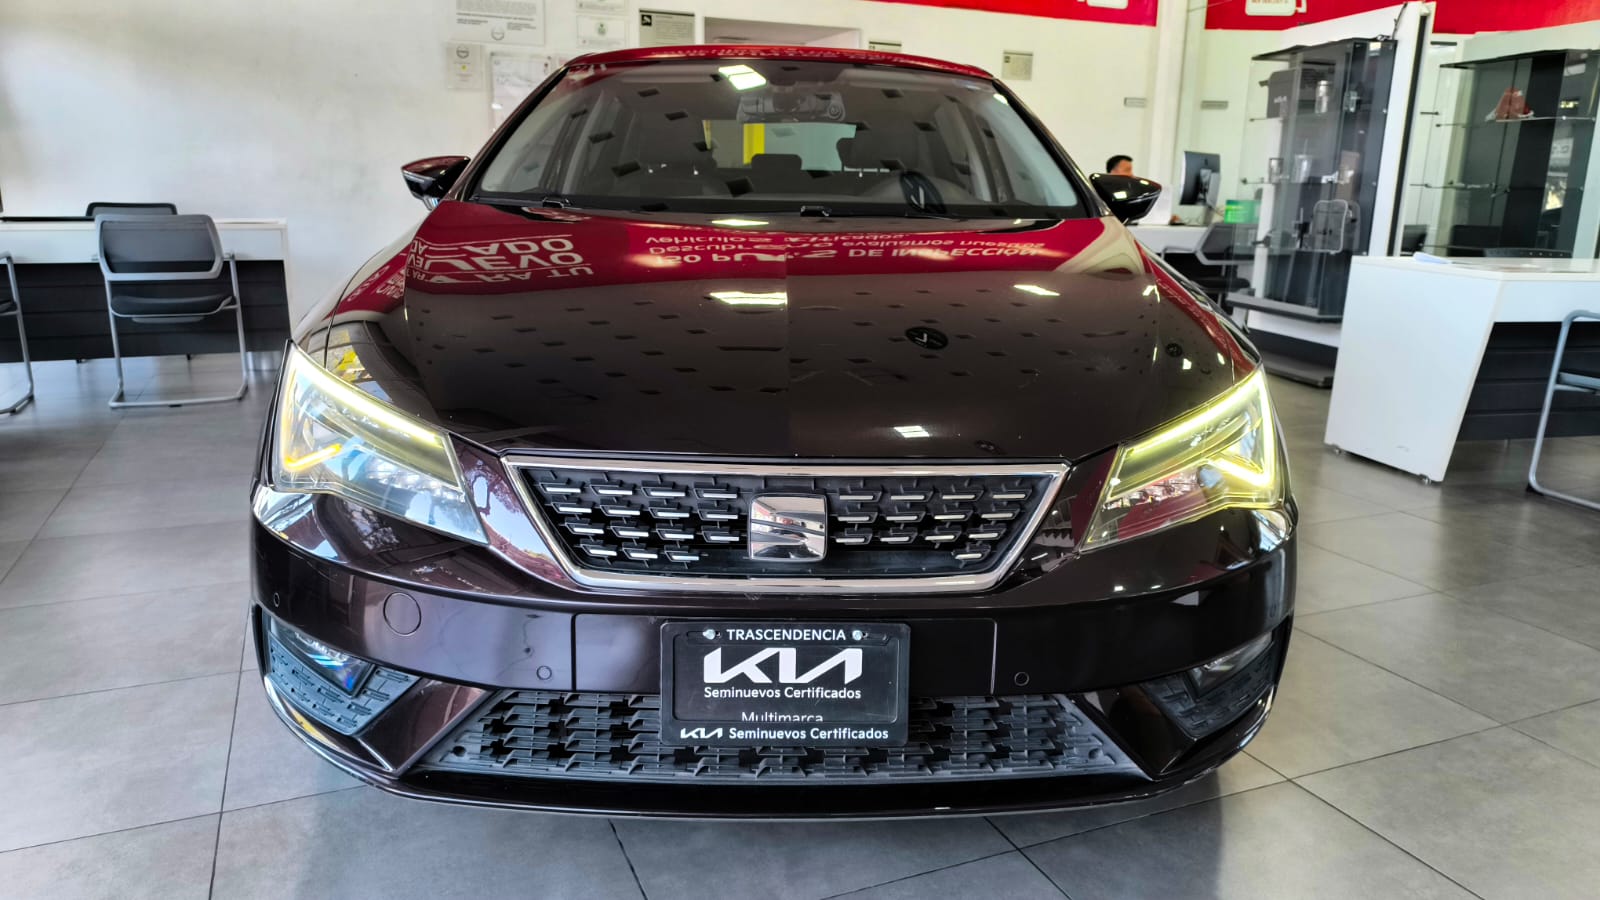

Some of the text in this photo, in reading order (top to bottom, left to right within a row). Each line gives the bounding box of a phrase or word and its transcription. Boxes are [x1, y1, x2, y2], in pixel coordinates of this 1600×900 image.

[727, 629, 846, 641] TRASCENDENCIA
[703, 647, 862, 685] KIA
[704, 686, 862, 699] Seminuevos Certificados
[741, 711, 823, 722] Multimarca
[680, 727, 889, 739] KIA Seminuevos Certificados
